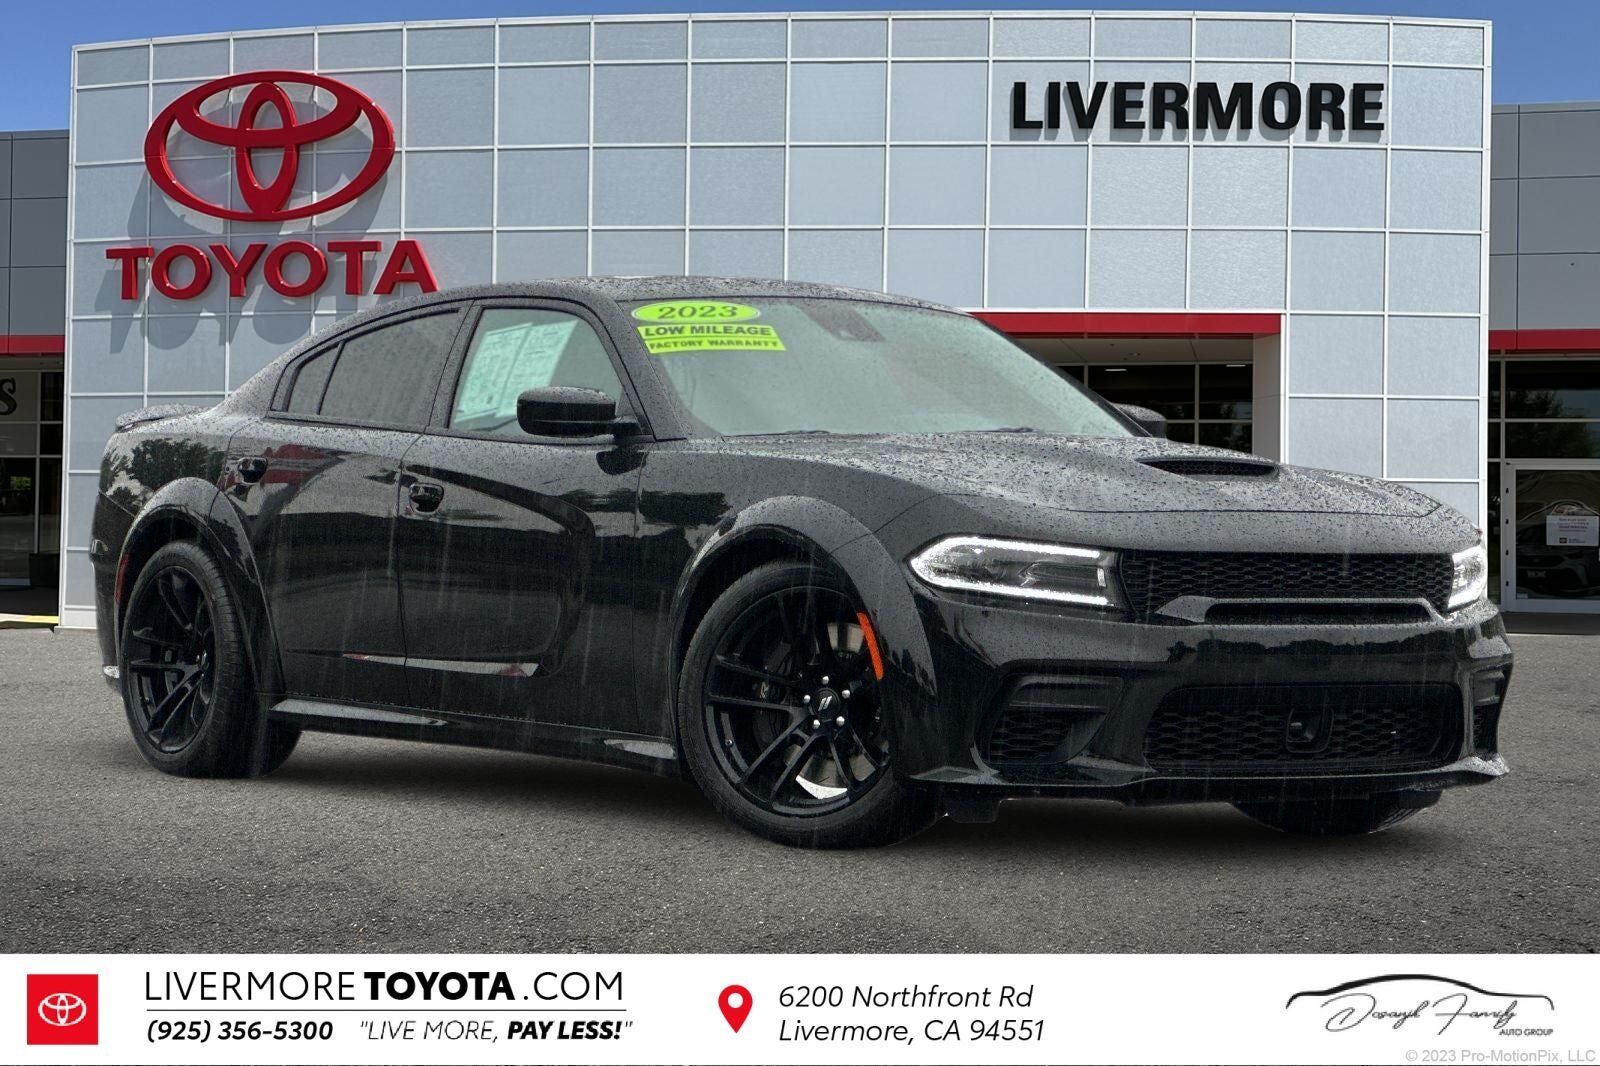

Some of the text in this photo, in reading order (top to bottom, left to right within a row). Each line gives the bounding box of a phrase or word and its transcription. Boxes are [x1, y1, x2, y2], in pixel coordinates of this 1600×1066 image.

[1012, 81, 1385, 131] LIVERMORE
[106, 239, 439, 300] TOYOTA
[657, 305, 738, 319] 2023
[644, 324, 772, 337] LOW MILEAGE
[650, 339, 778, 349] FACTORY WARRANTY
